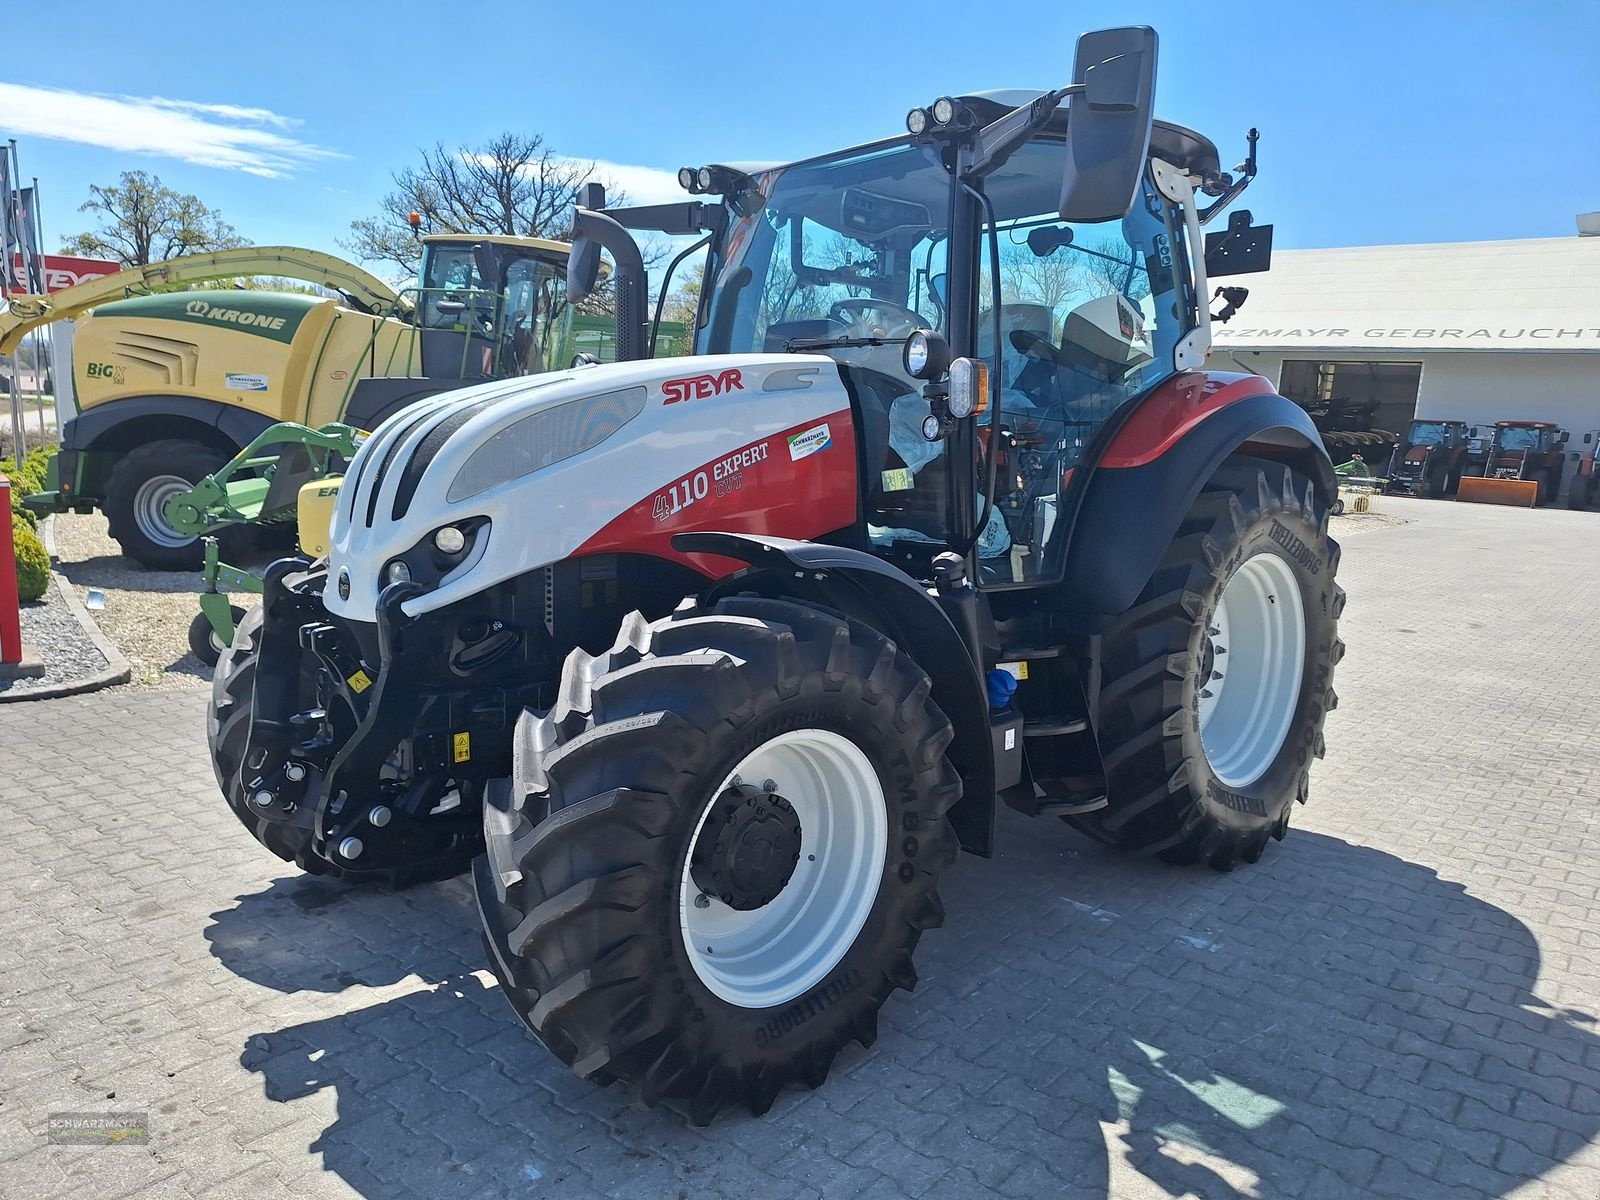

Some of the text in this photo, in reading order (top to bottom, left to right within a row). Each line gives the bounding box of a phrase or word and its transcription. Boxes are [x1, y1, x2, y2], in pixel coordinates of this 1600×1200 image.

[207, 307, 287, 330] KRONE
[662, 368, 744, 405] STEYR
[652, 442, 768, 521] 4110 EXPERT
[715, 472, 744, 498] CVT
[1268, 518, 1322, 575] TRELLEBORG
